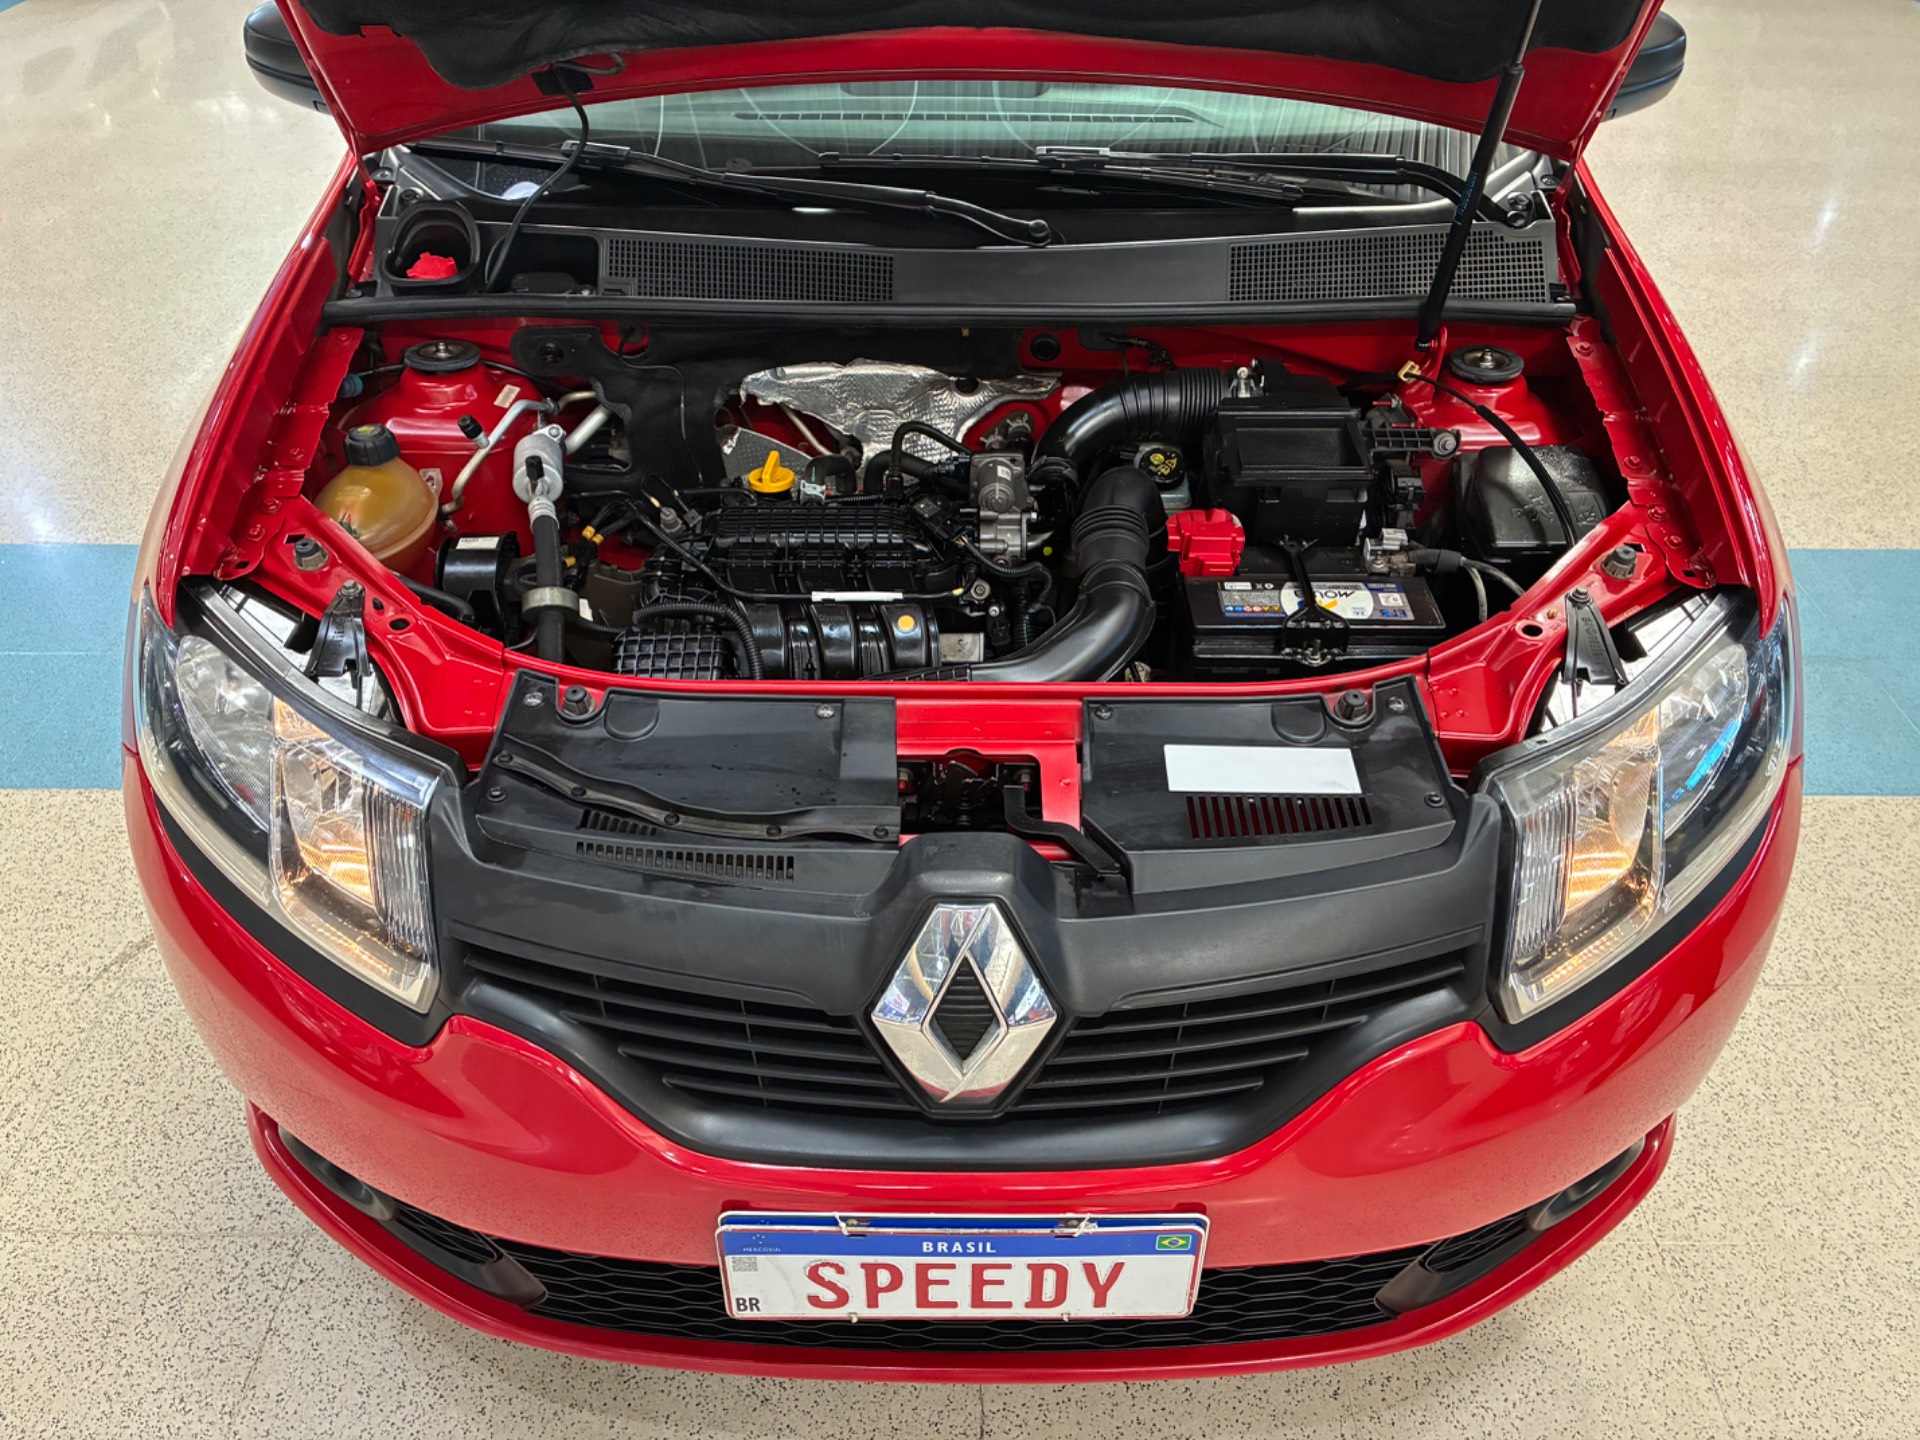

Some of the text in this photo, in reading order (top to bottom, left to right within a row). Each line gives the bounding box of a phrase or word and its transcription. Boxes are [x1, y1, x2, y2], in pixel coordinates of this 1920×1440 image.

[922, 1241, 997, 1254] BRASIL
[806, 1261, 1126, 1309] SPEEDY
[735, 1297, 761, 1313] BR
